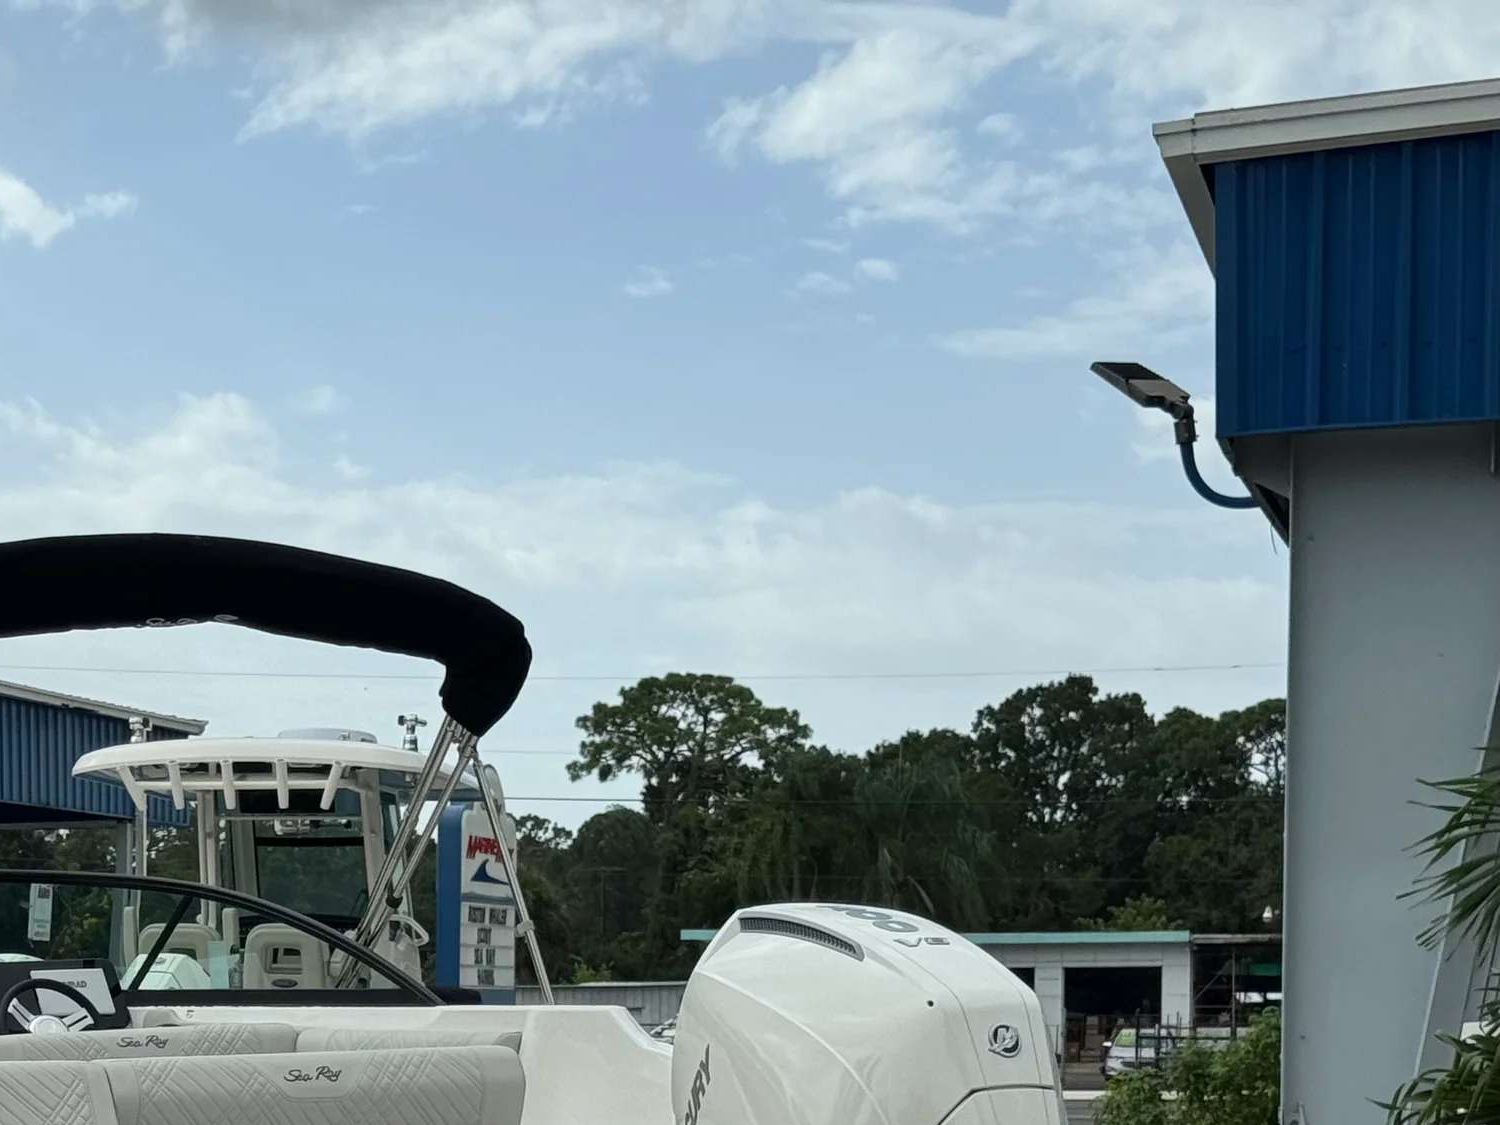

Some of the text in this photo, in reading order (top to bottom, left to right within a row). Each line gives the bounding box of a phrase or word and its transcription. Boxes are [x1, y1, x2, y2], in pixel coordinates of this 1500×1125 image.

[117, 1034, 169, 1049] Sea Ray
[283, 1066, 343, 1083] Sea Ray
